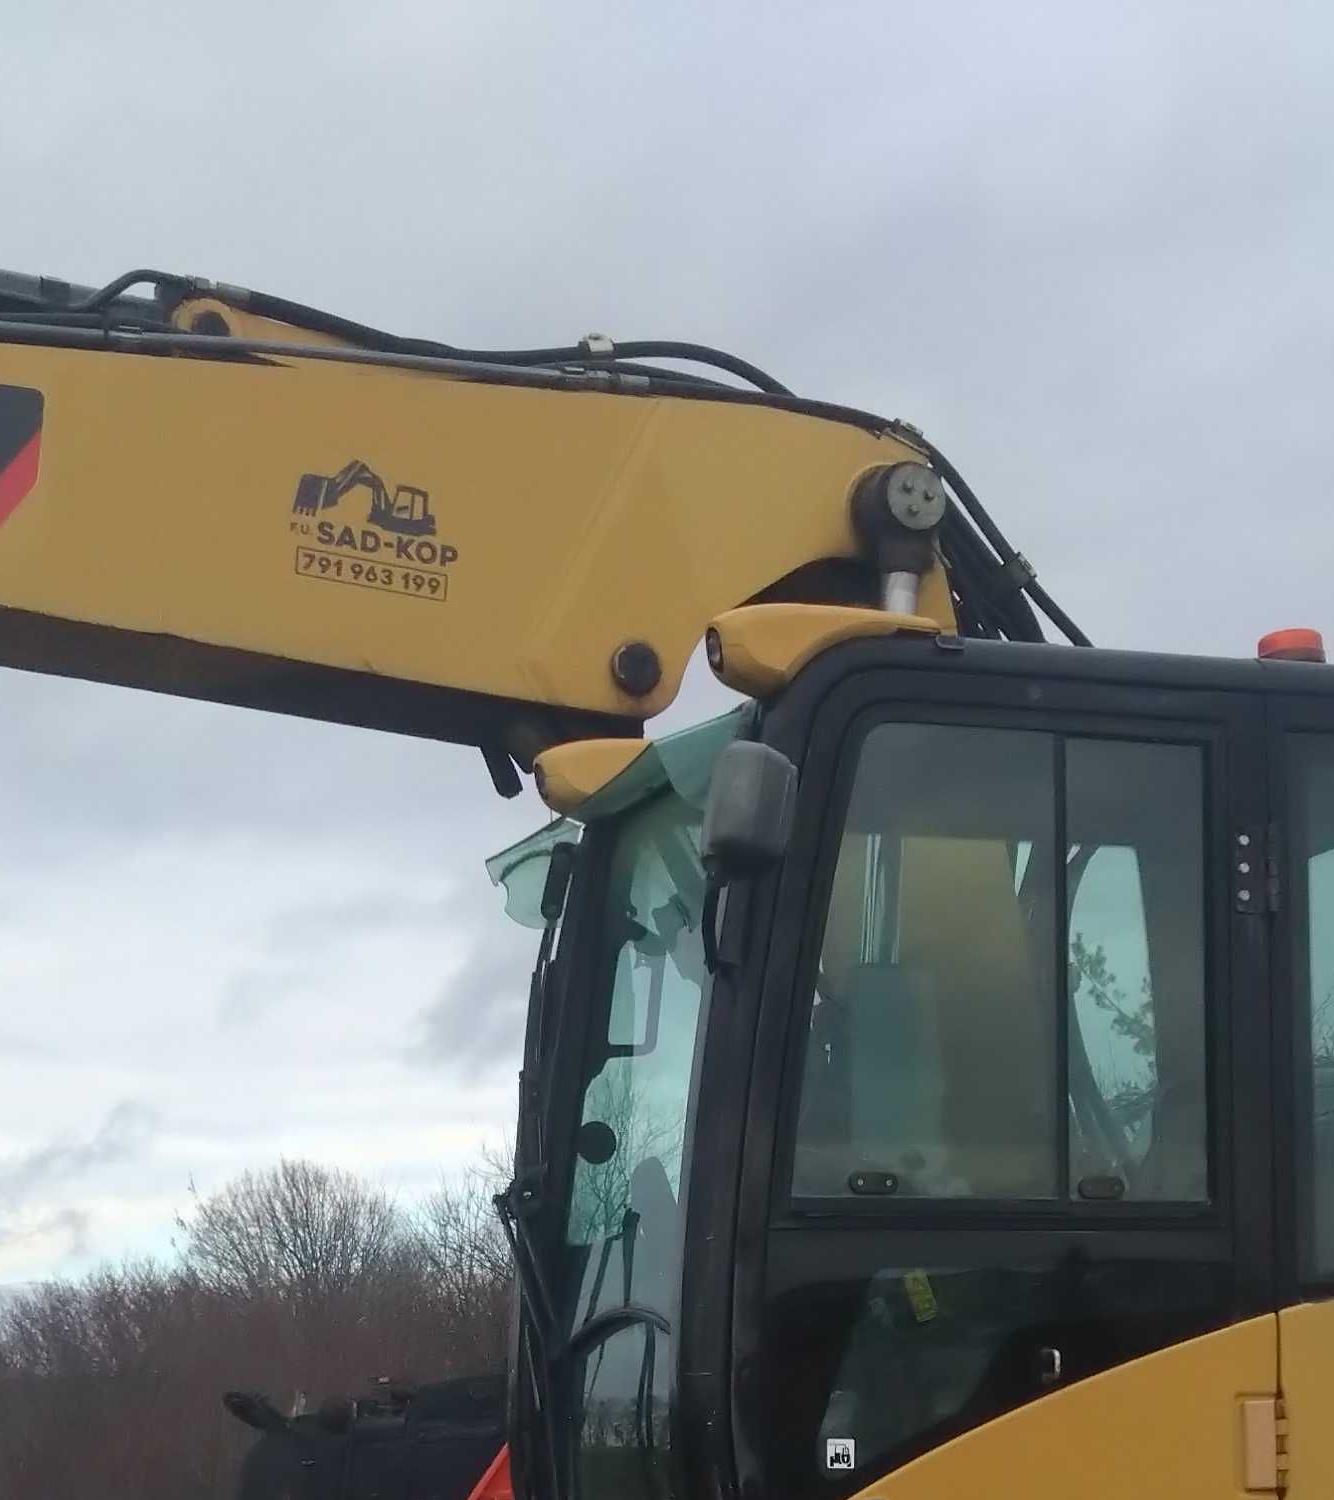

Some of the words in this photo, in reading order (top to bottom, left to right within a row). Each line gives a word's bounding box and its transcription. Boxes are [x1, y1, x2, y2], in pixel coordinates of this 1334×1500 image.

[317, 520, 458, 567] SAD-KOP
[302, 553, 343, 577] 791
[350, 563, 393, 586] 963
[401, 572, 441, 595] 199
